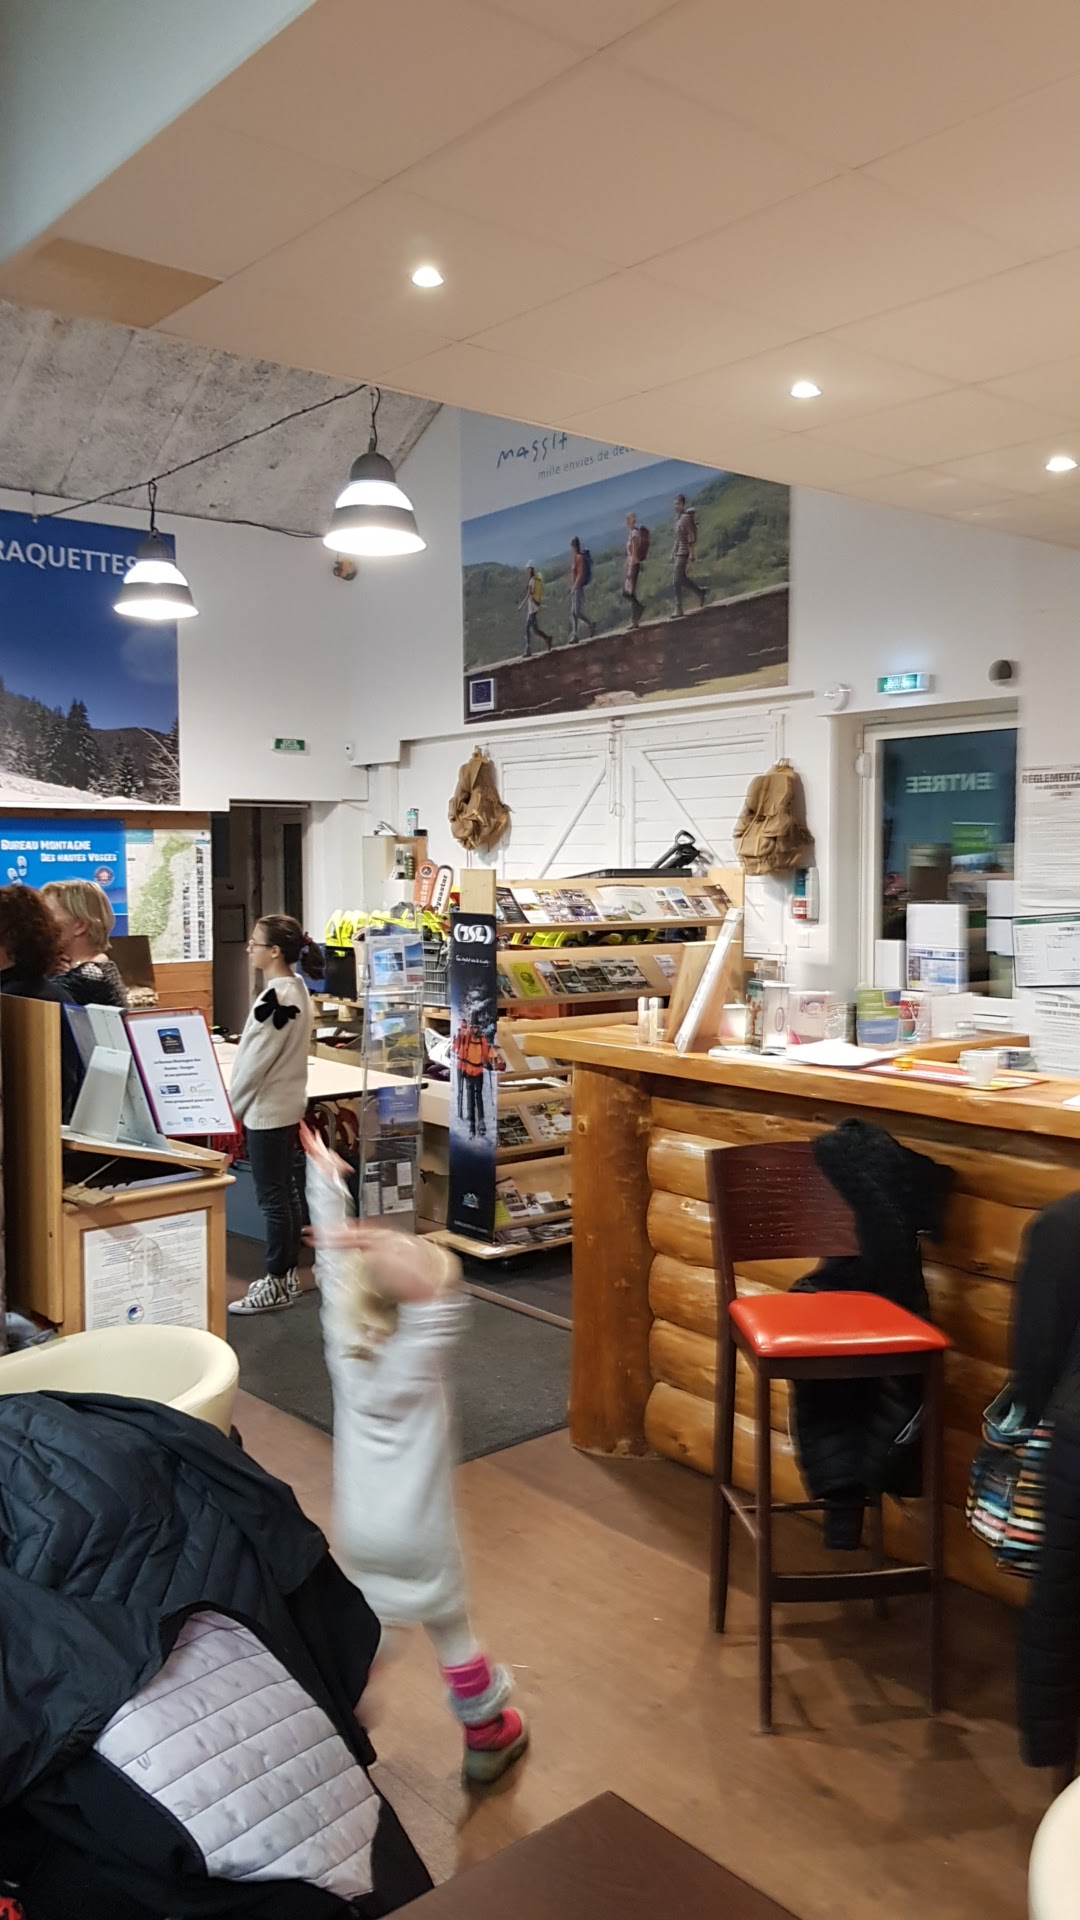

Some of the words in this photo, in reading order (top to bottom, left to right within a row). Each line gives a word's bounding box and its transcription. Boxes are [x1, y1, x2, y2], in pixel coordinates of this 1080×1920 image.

[538, 465, 561, 480] mille
[563, 457, 595, 472] envies
[597, 450, 610, 462] de
